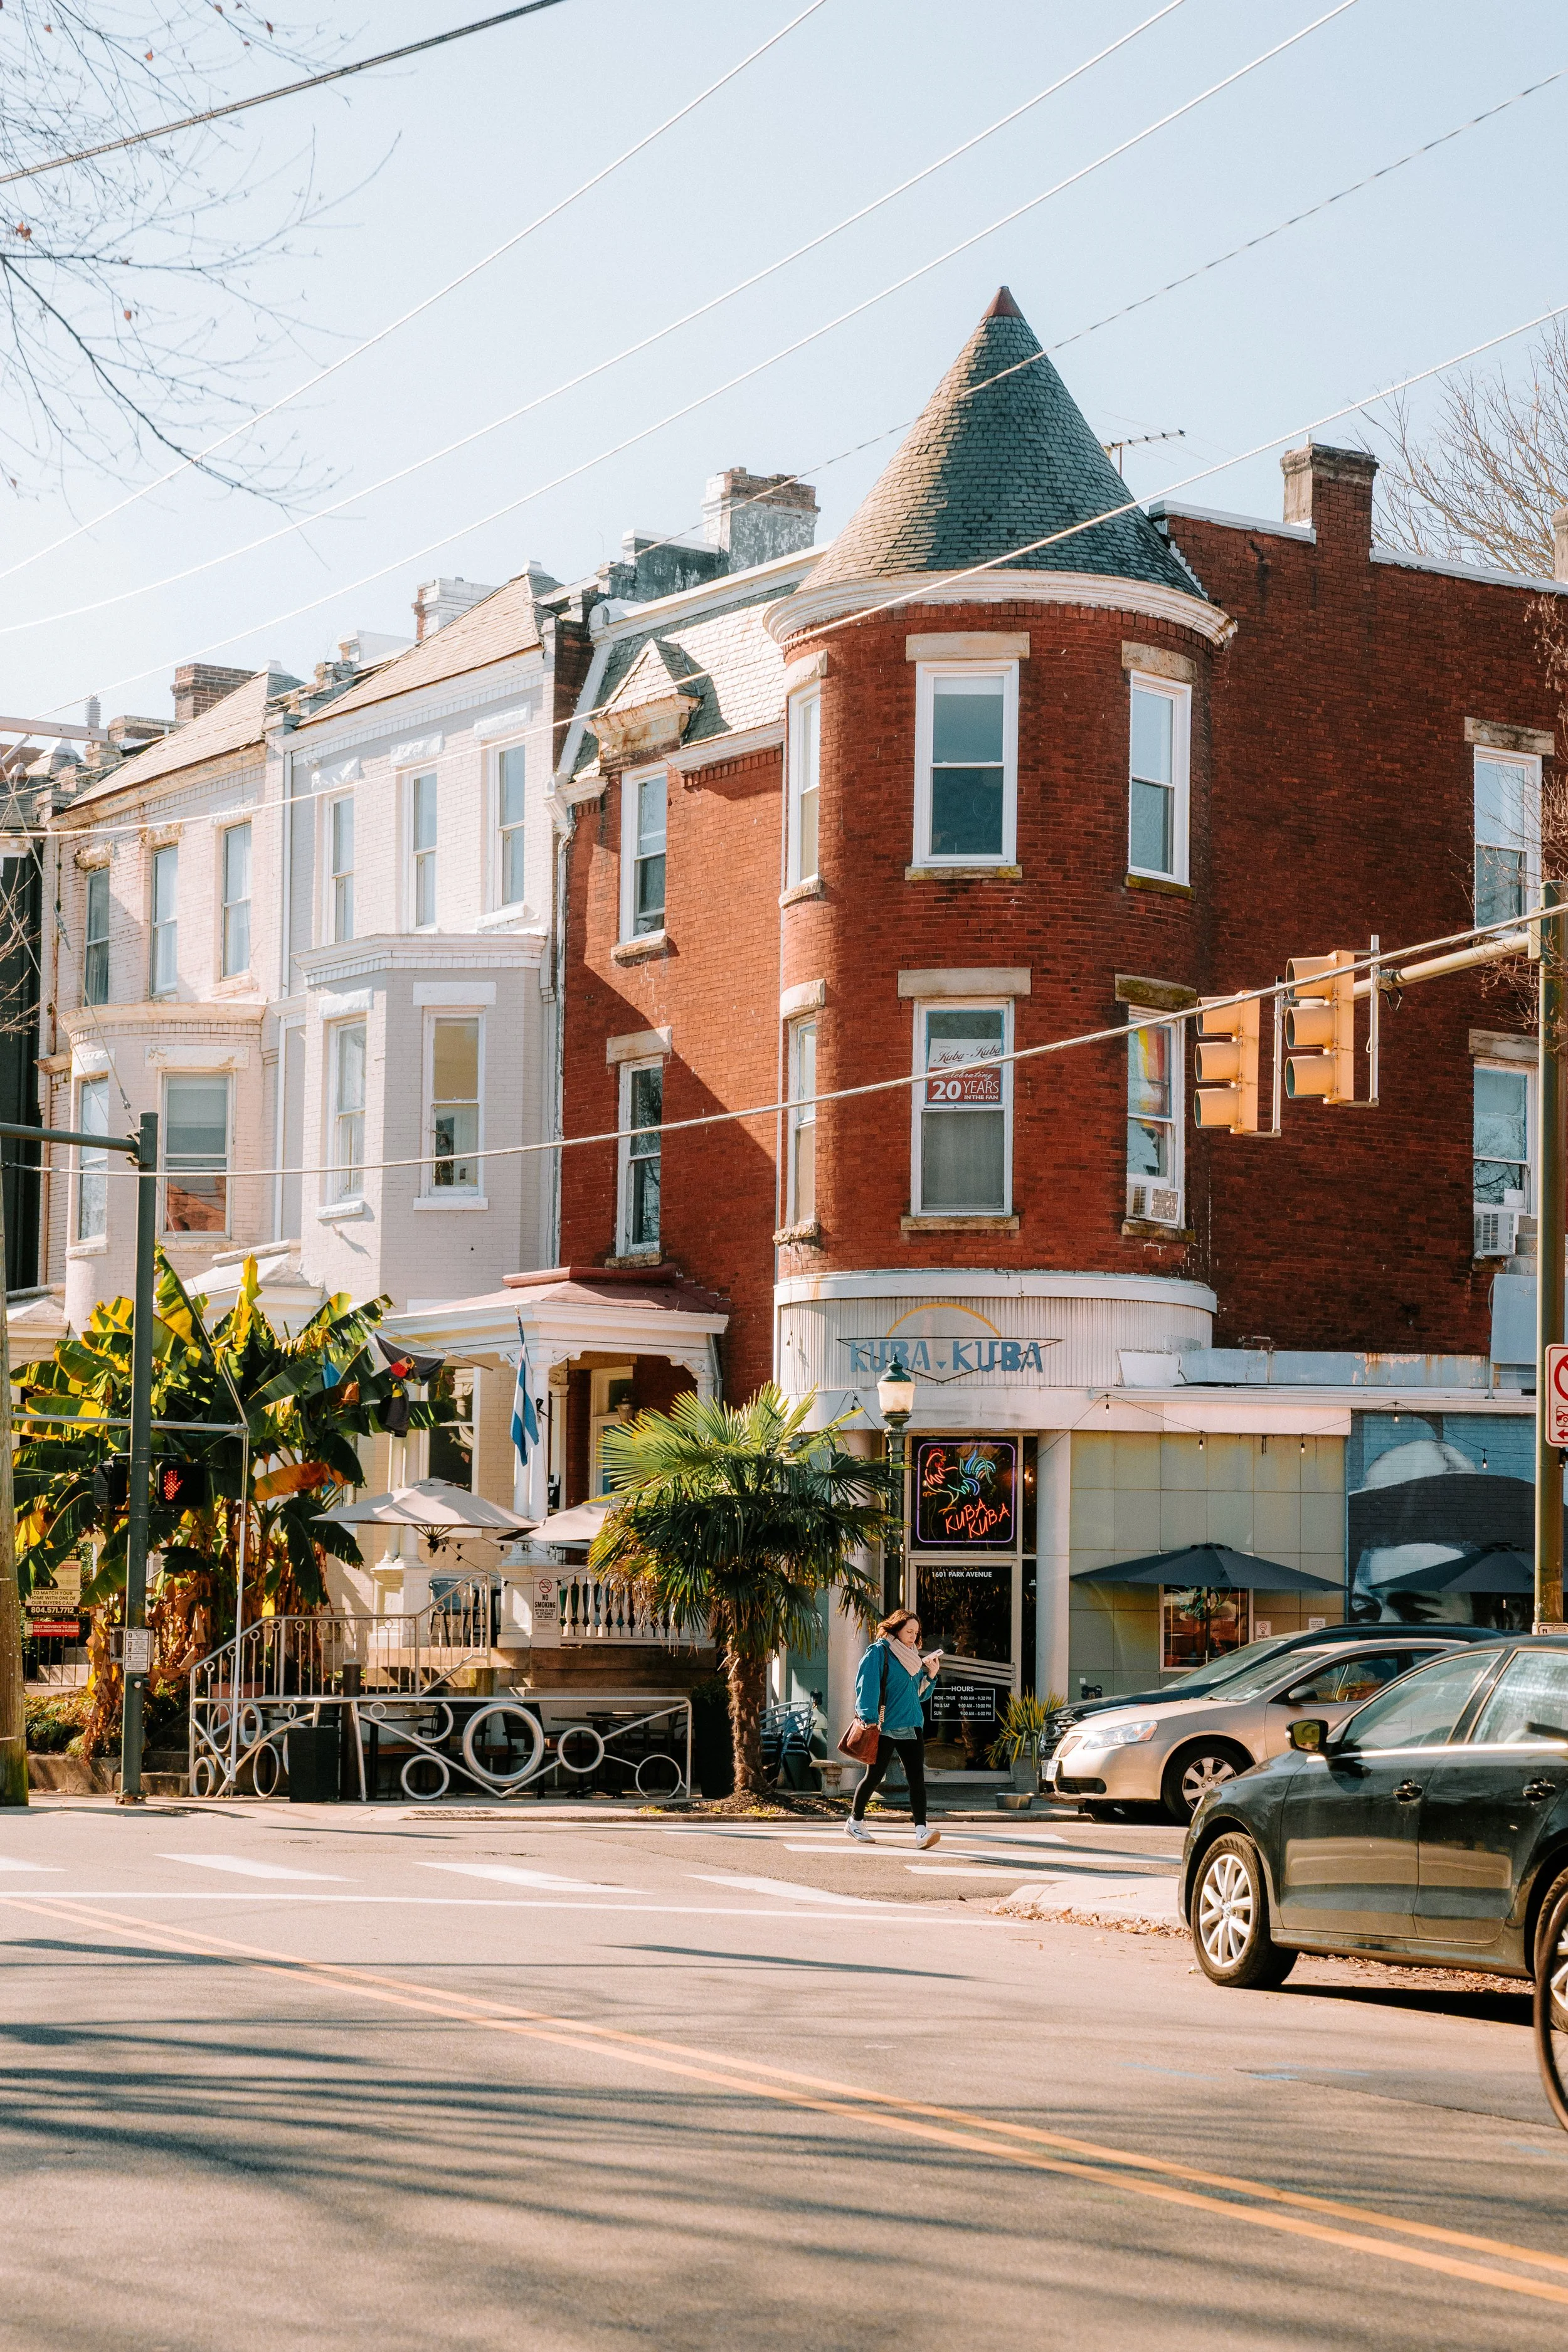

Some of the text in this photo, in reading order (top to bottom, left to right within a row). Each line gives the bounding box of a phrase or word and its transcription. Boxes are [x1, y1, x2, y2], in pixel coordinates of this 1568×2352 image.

[931, 1080, 999, 1099] 20 YEARS
[939, 1069, 993, 1082] elebrating
[850, 1340, 1044, 1373] KUBA KUBA
[945, 1498, 987, 1534] KUBA
[968, 1503, 1010, 1539] KUBA
